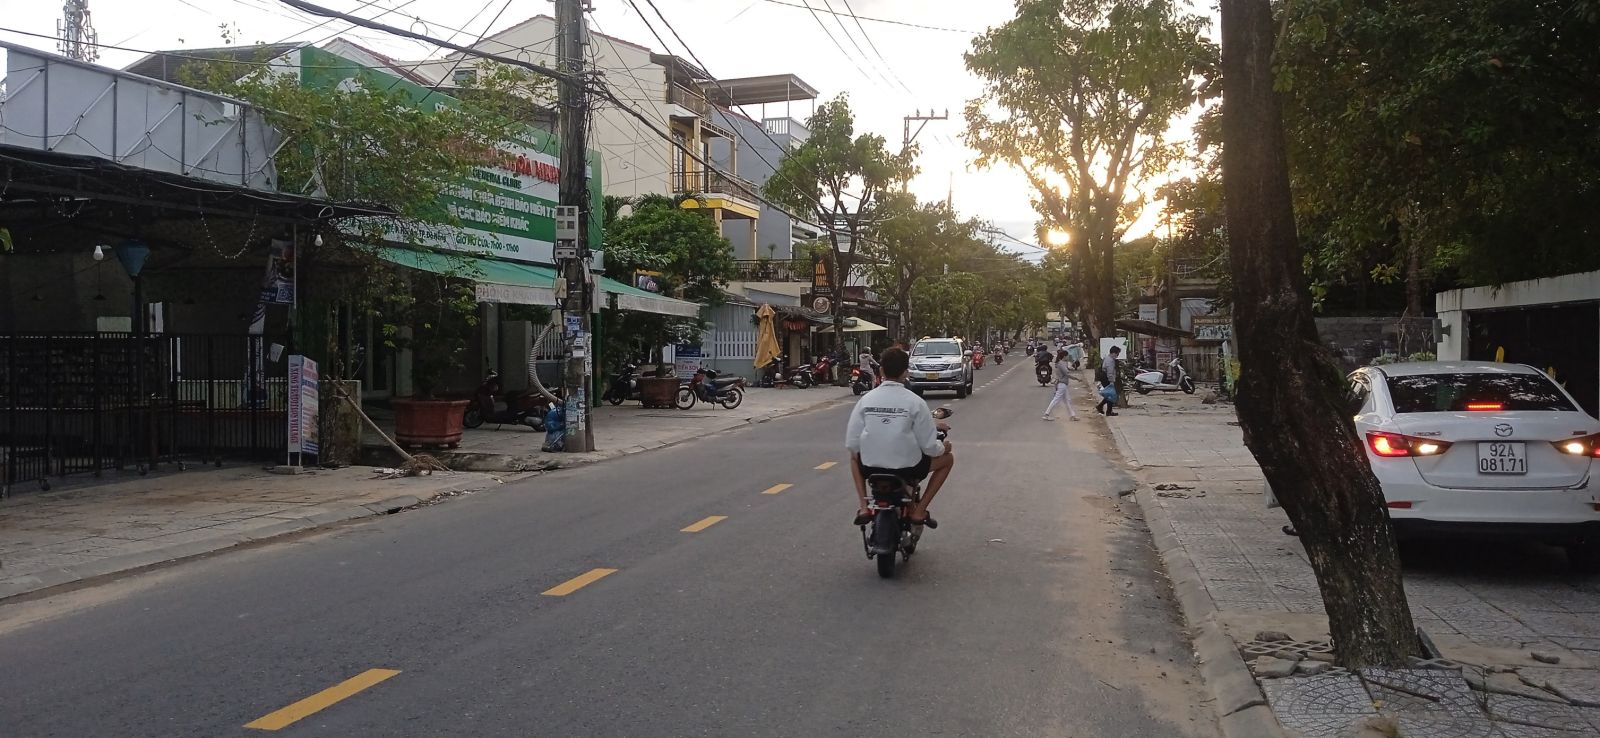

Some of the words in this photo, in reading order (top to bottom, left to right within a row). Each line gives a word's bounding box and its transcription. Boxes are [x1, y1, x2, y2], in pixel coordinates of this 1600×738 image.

[495, 192, 515, 210] BỆNH
[515, 197, 529, 213] BẢO
[475, 208, 491, 224] BẢO
[1490, 444, 1515, 457] 92A
[1481, 459, 1525, 471] 081.71
